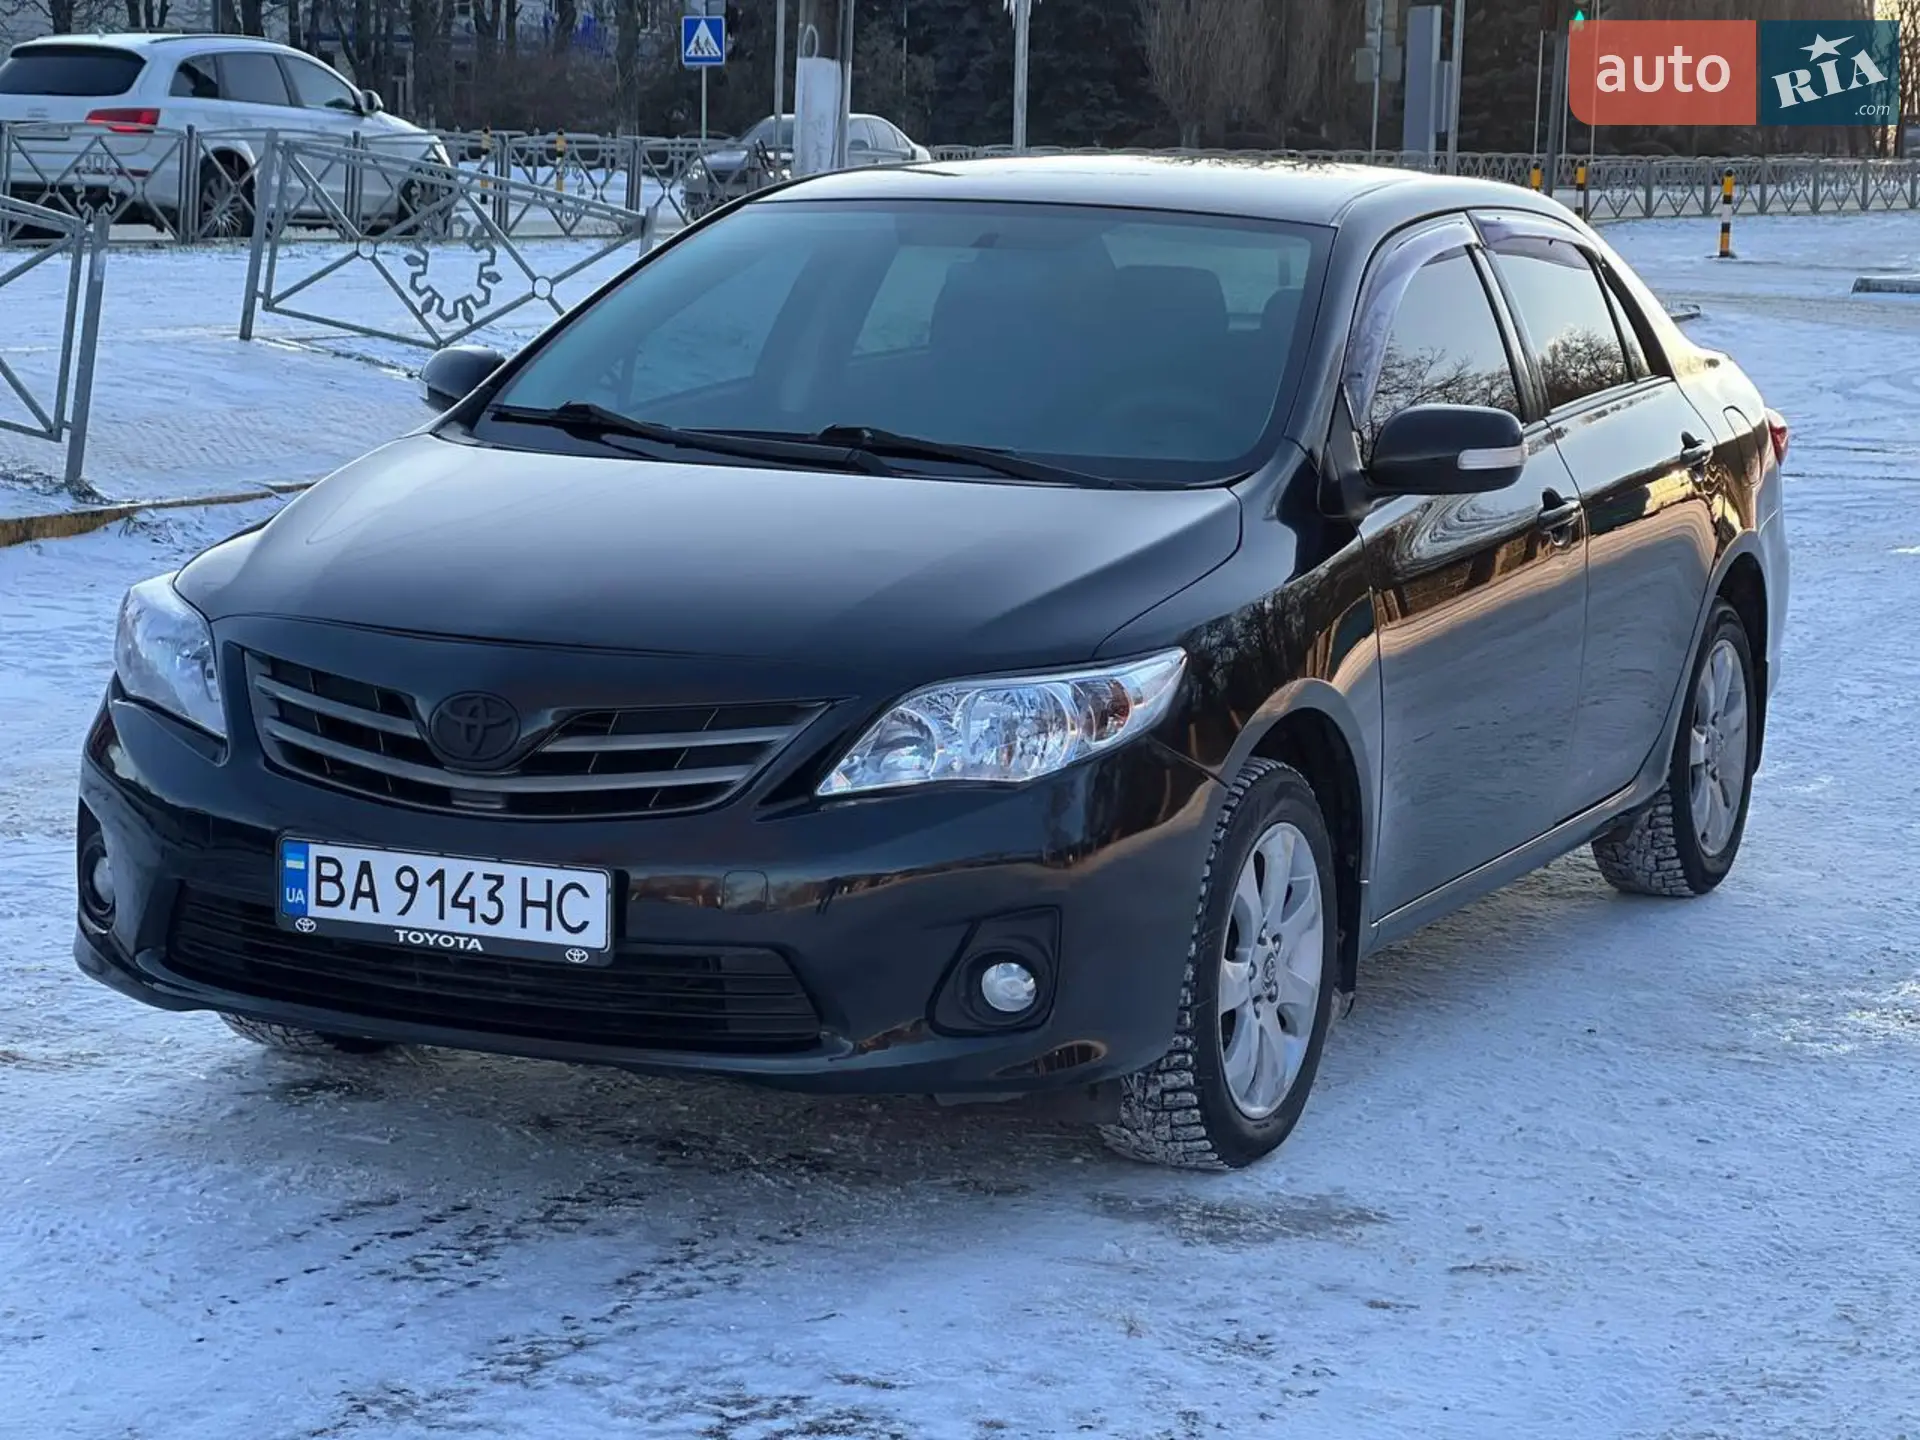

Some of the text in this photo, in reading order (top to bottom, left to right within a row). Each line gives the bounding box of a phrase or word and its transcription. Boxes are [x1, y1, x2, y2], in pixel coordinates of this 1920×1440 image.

[285, 886, 305, 905] UA
[315, 855, 590, 934] BA 9143 HC
[394, 928, 484, 952] TOYOTA
